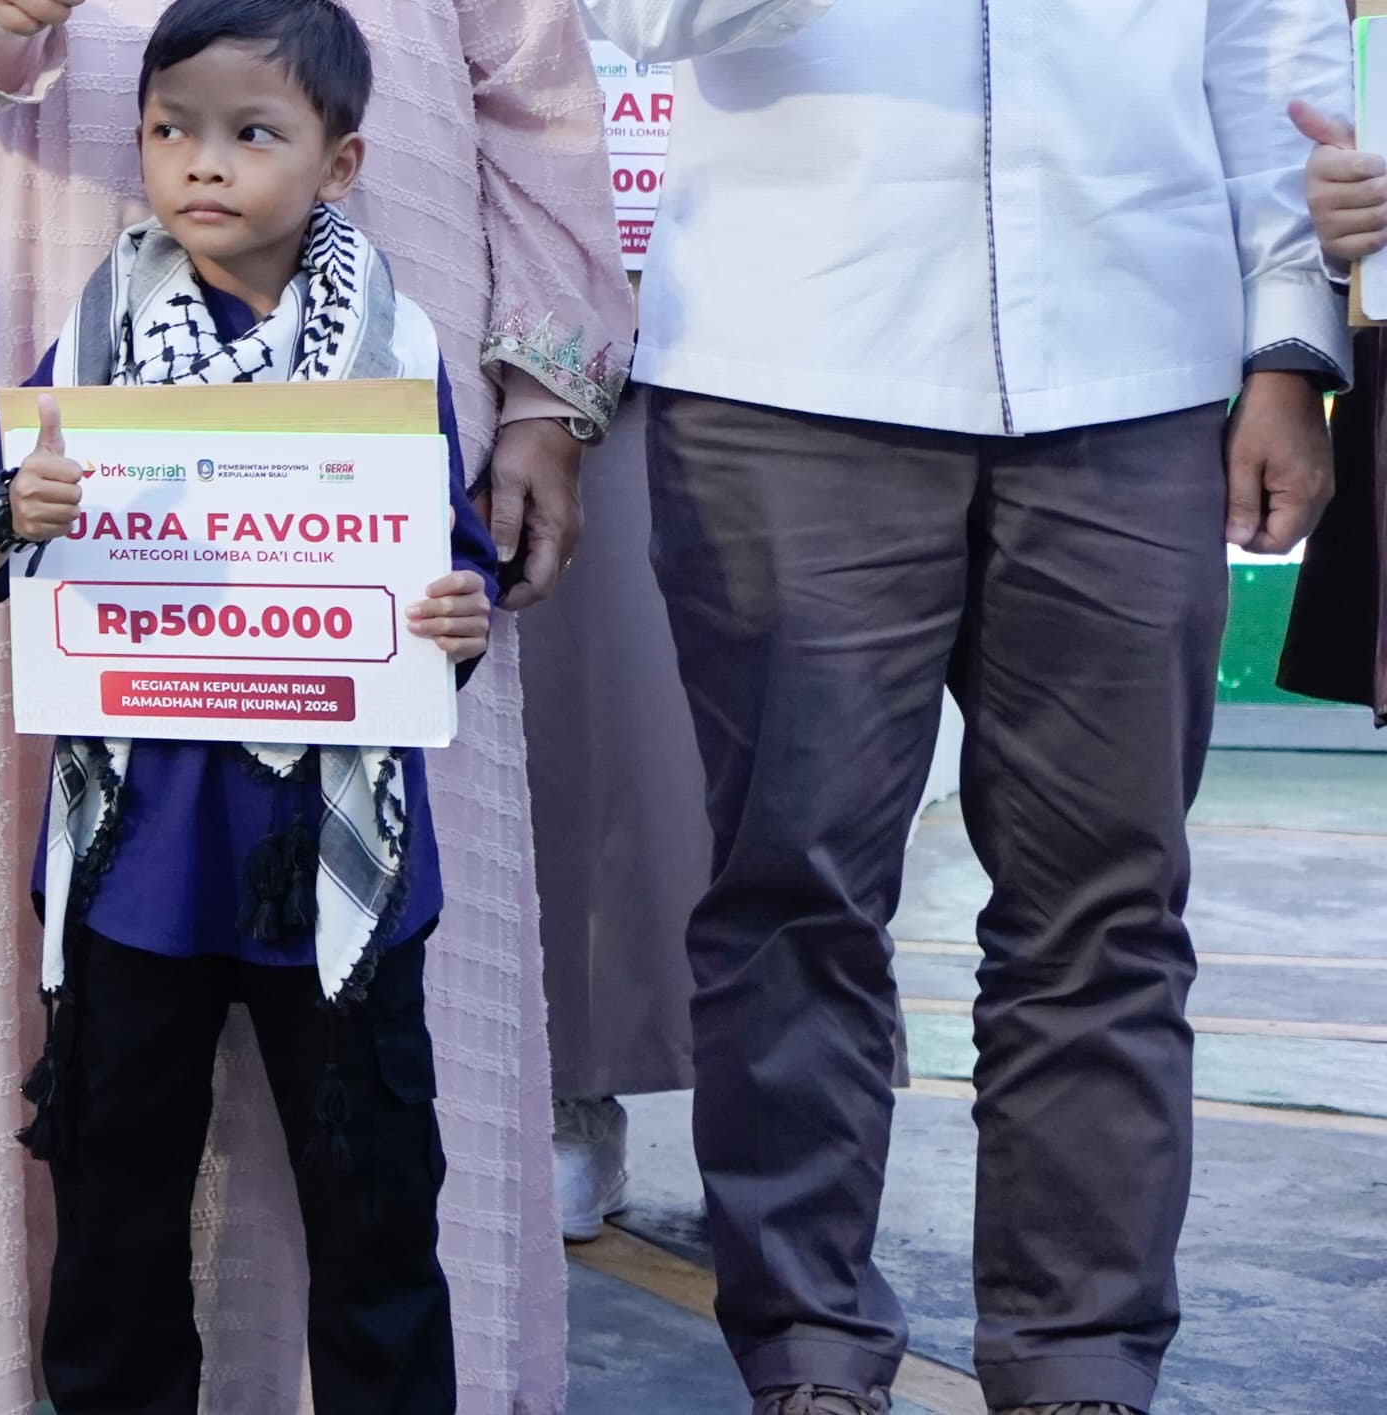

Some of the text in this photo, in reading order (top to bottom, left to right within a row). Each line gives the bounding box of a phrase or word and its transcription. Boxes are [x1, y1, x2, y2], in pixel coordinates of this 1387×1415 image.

[595, 64, 627, 74] ariah
[101, 463, 186, 480] brksyariah
[217, 471, 288, 479] KEPULAUAN RIAU
[325, 463, 354, 473] GERAK
[66, 512, 409, 543] UARA FAVORIT
[109, 549, 334, 563] KATEGORI LOMBA DA'I CILIK
[97, 603, 352, 643] Rp500.000
[131, 679, 325, 695] KEGIATAN KEPULAUAN RIAU
[121, 696, 338, 713] RAMADHAN FAIR (KURMA) 2026
